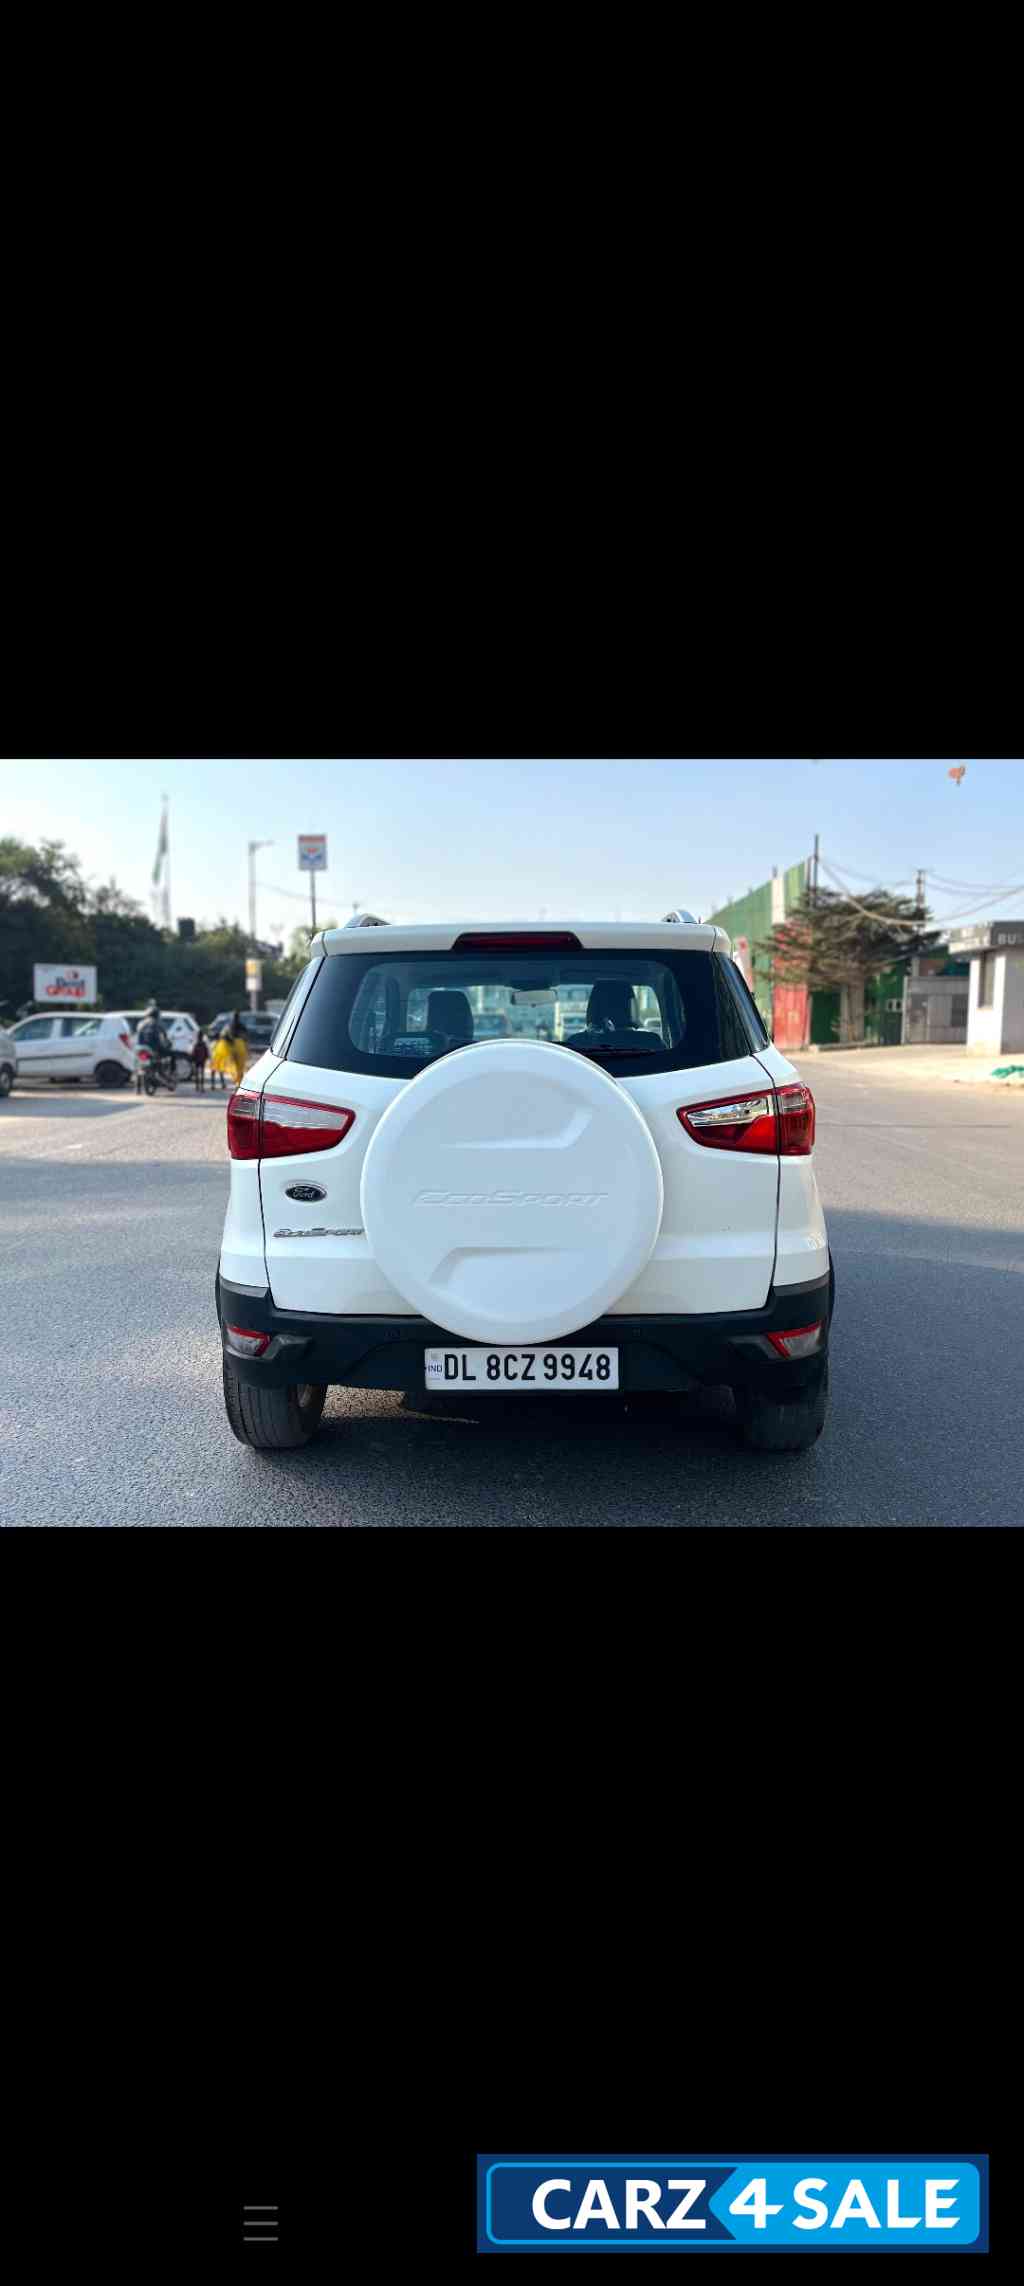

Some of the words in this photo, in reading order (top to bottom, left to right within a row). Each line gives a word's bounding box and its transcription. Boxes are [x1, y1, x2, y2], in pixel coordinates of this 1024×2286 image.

[427, 1364, 443, 1373] IND
[443, 1353, 477, 1381] DL
[486, 1353, 536, 1381] 8CZ
[543, 1353, 611, 1381] 9948
